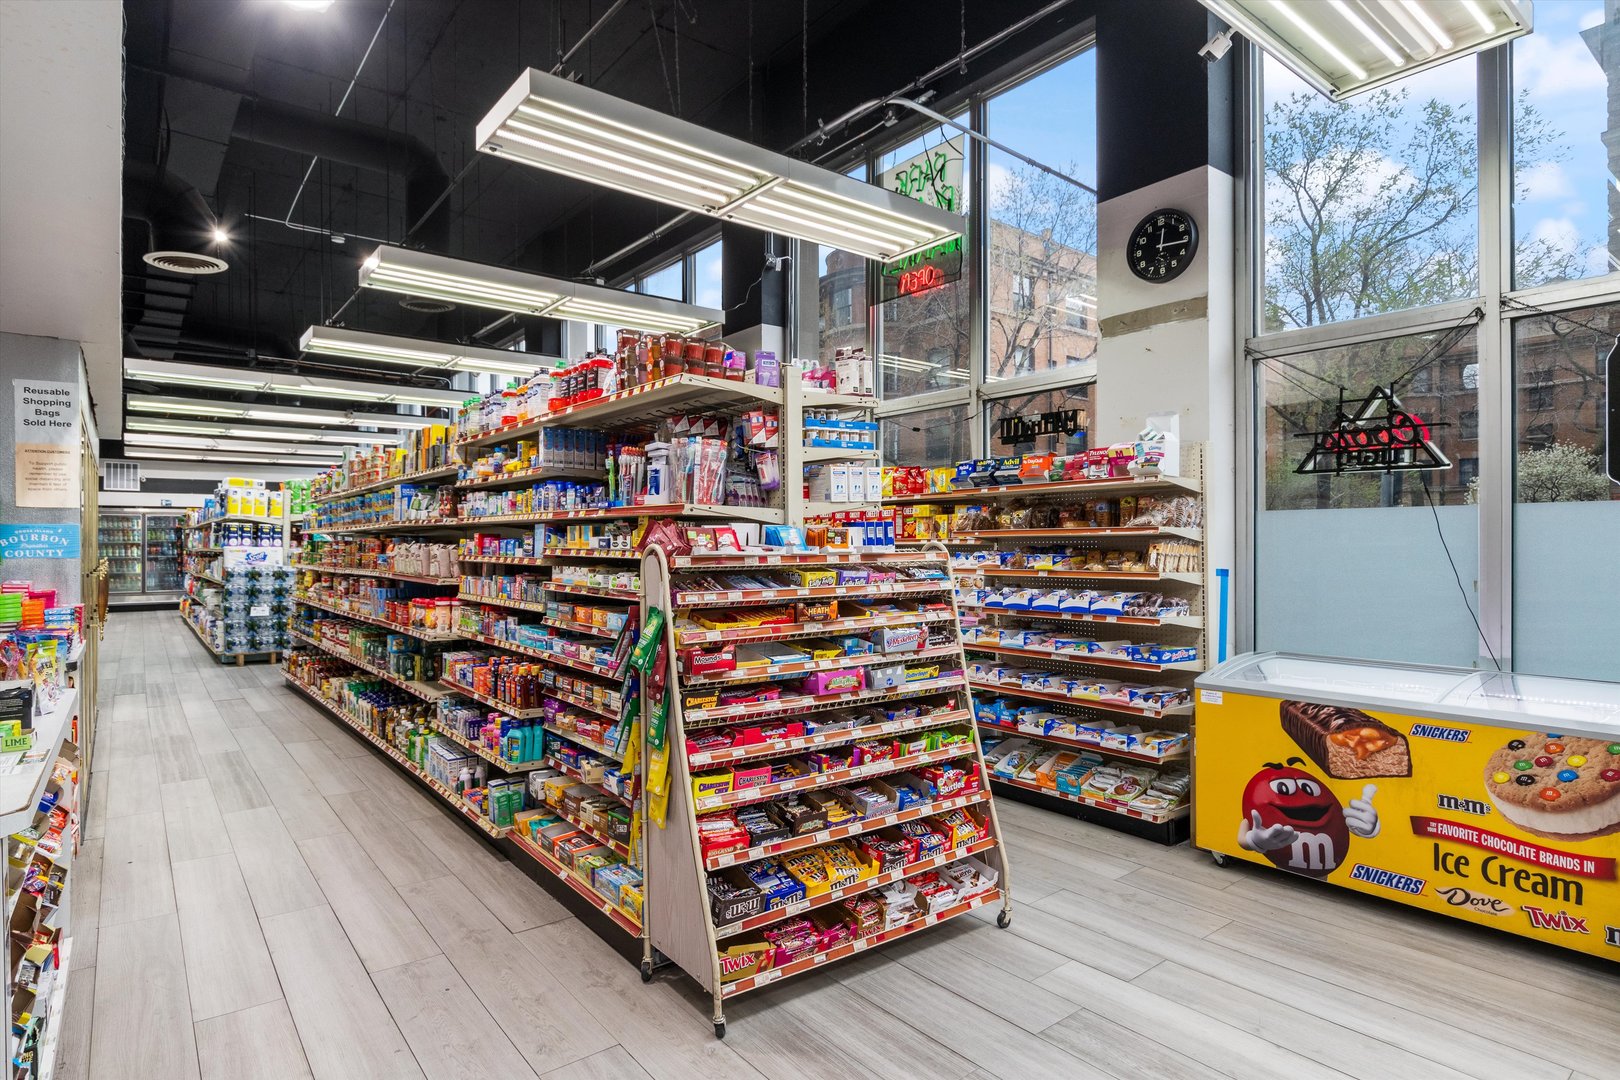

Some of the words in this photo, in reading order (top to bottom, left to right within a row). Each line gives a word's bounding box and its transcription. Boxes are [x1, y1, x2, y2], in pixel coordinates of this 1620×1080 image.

[1179, 224, 1185, 232] 2
[1140, 237, 1146, 245] 10
[23, 386, 70, 396] Reusable
[23, 398, 71, 408] Shopping
[34, 408, 60, 418] Bags
[23, 418, 46, 426] Sold
[0, 534, 69, 546] BOURBON
[4, 550, 64, 558] COUNTY
[808, 606, 830, 614] HEATH
[694, 654, 722, 665] Mounds
[686, 696, 718, 706] CHARLESTON
[1411, 724, 1468, 742] SNICKERS
[5, 738, 28, 746] LIME
[738, 775, 768, 786] CHARLESTON
[698, 781, 730, 792] CHARLESTON
[940, 782, 965, 796] Skittles
[1438, 794, 1490, 815] m&m's
[1438, 823, 1478, 844] FAVORITE
[1481, 834, 1536, 861] CHOCOLATE
[1540, 851, 1580, 871] BRANDS
[1584, 860, 1594, 874] IN
[1353, 865, 1423, 894] SNICKERS
[1434, 842, 1470, 878] Ice
[1481, 856, 1584, 906] Cream
[1434, 887, 1510, 912] Dove
[1522, 905, 1590, 934] Twix
[860, 926, 880, 938] Twix
[720, 954, 756, 975] Twix
